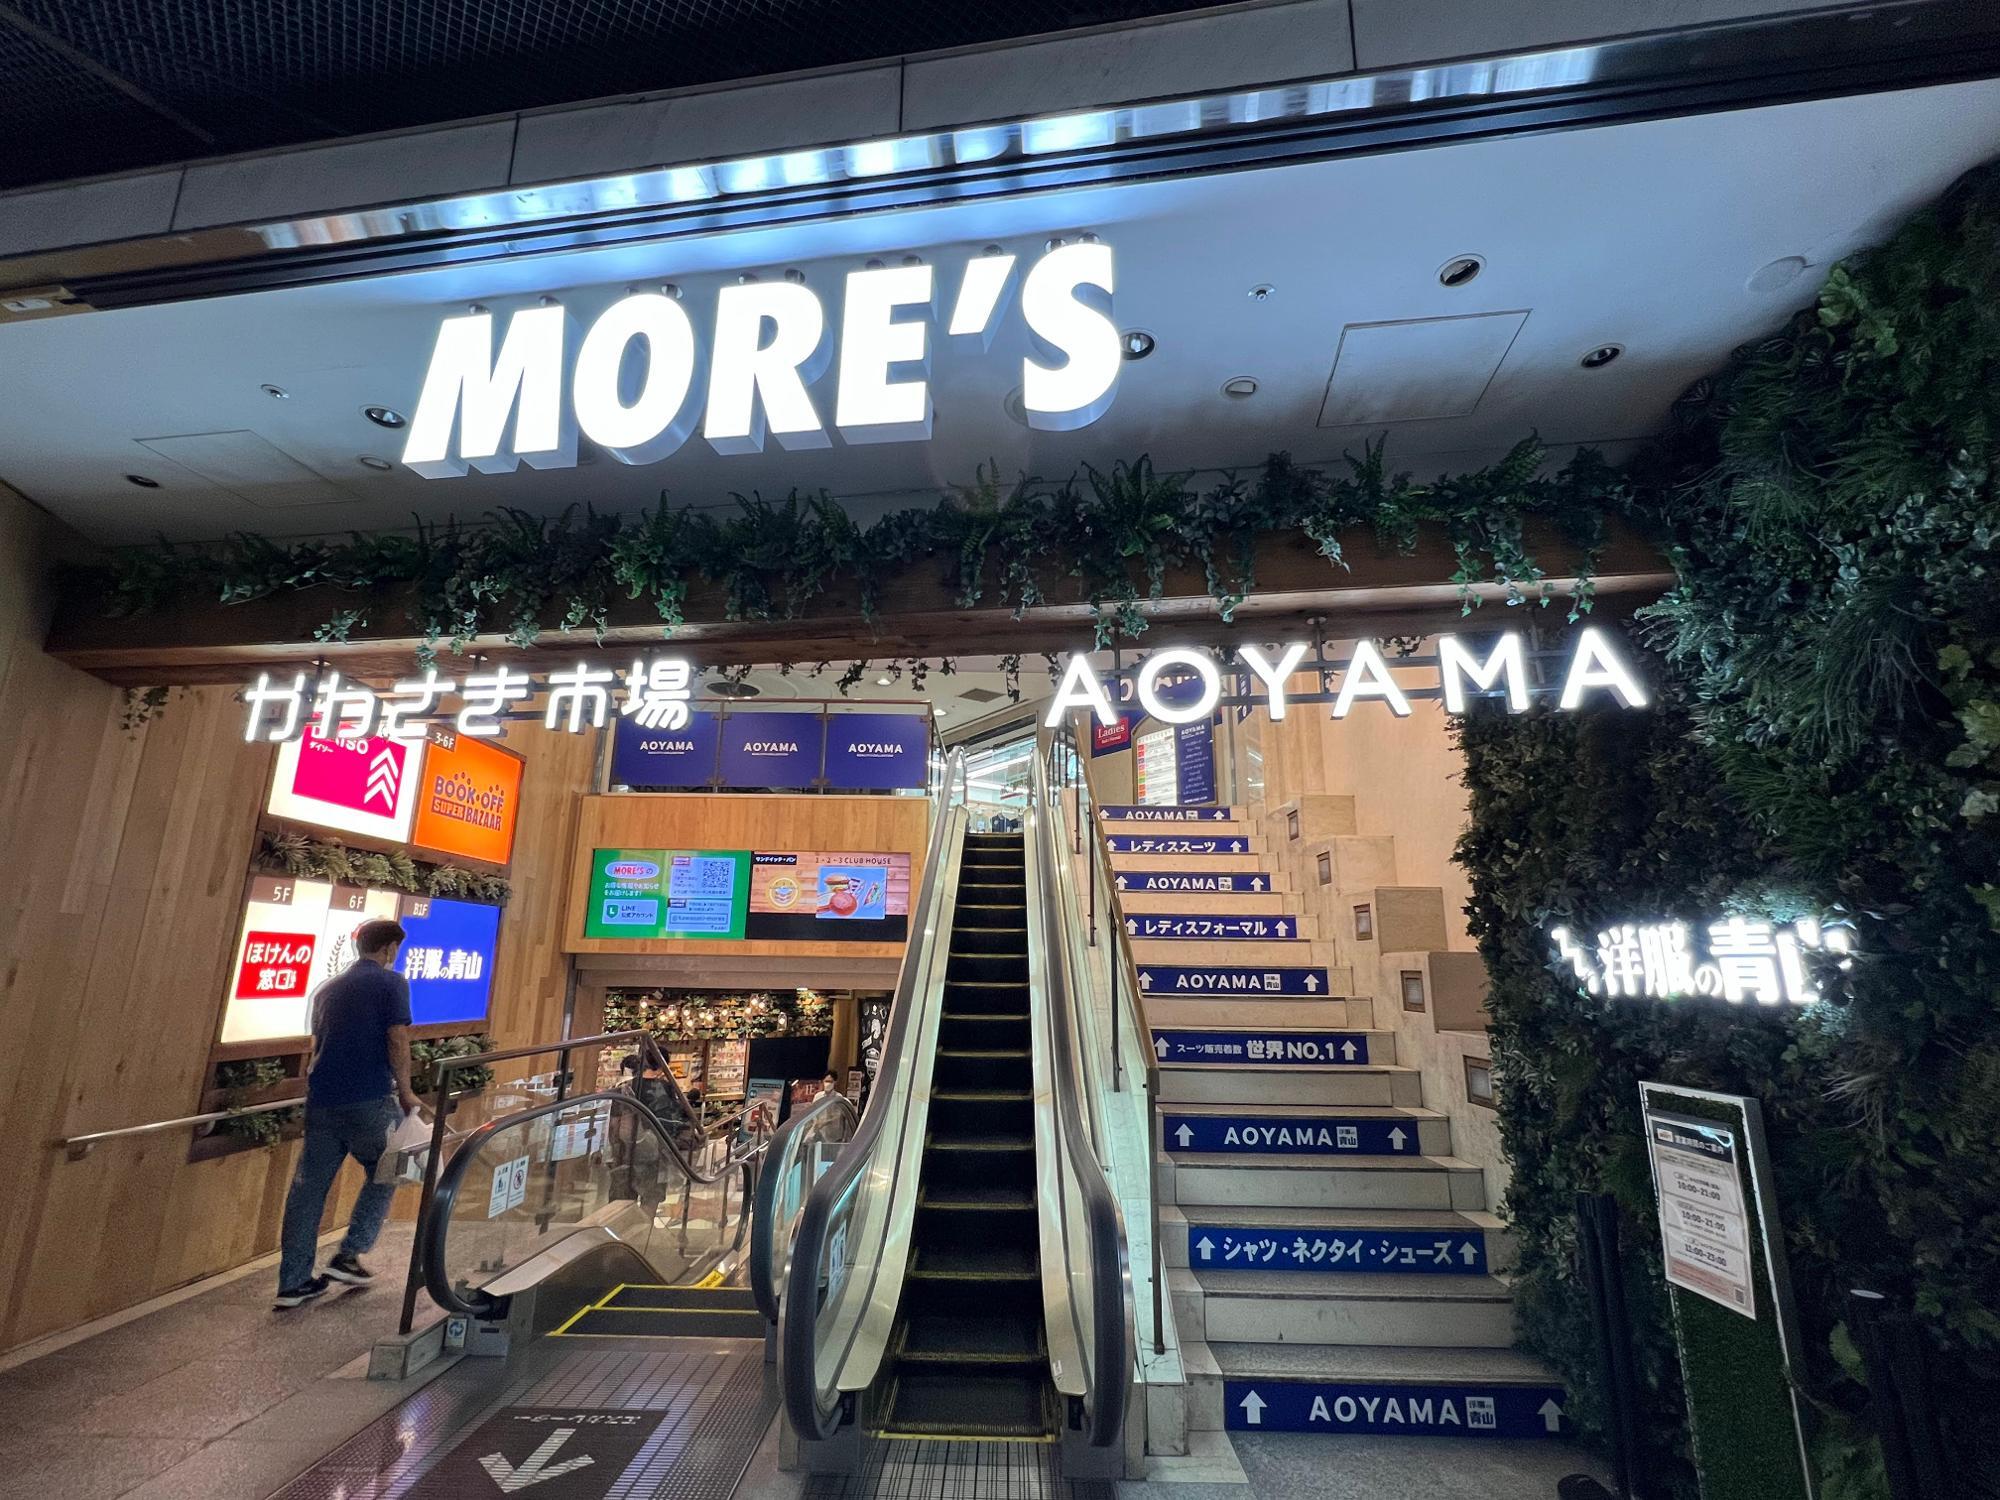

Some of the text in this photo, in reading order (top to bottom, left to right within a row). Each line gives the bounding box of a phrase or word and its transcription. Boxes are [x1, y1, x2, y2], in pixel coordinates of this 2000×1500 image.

[402, 243, 1122, 465] MORE'S
[1045, 627, 1646, 728] AOYAMA
[245, 660, 690, 742] かわさき市場
[435, 732, 454, 749] 3-6F
[640, 740, 694, 751] AOYAMA
[743, 741, 799, 753] AOYAMA
[848, 743, 903, 754] AOYAMA
[433, 800, 502, 831] SUPER BAZAAR
[1125, 811, 1185, 821] AOYAMA
[1130, 840, 1216, 853] レディススーツ
[1146, 877, 1217, 890] AOYAMA
[272, 886, 291, 902] 5F
[349, 894, 364, 909] 6F
[412, 903, 428, 917] B1F
[1145, 919, 1268, 936] レディスフォーマル
[246, 942, 311, 965] ほけんの
[405, 947, 482, 980] 洋服の青山
[1176, 973, 1261, 989] AOYAMA
[1224, 1126, 1333, 1146] AOYAMA
[1223, 1236, 1453, 1265] シャツ・ネクタイ・シューズ
[1309, 1396, 1461, 1425] AOYAMA
